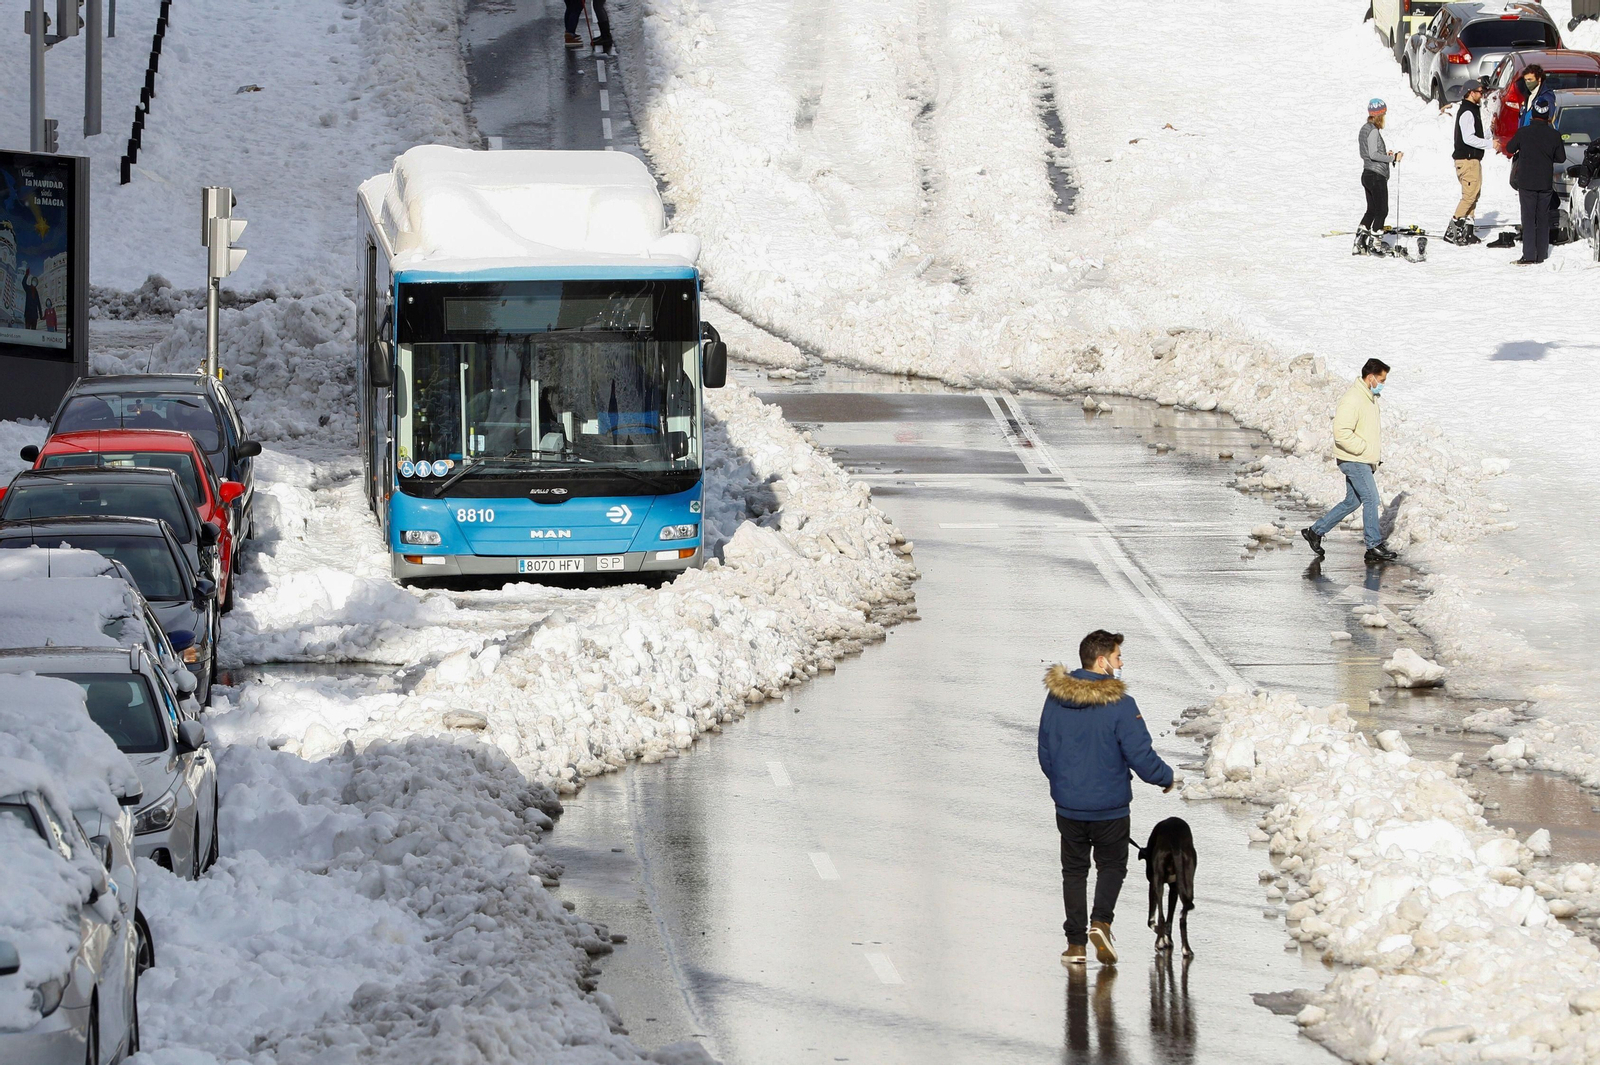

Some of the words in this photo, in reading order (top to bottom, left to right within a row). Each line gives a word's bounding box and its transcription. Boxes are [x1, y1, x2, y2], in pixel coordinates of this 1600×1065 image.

[26, 178, 32, 186] la
[34, 196, 41, 204] la
[42, 198, 64, 206] MAGIA
[456, 508, 495, 523] 8810
[530, 529, 571, 539] MAN
[526, 560, 556, 572] 8070
[559, 559, 581, 571] HFV
